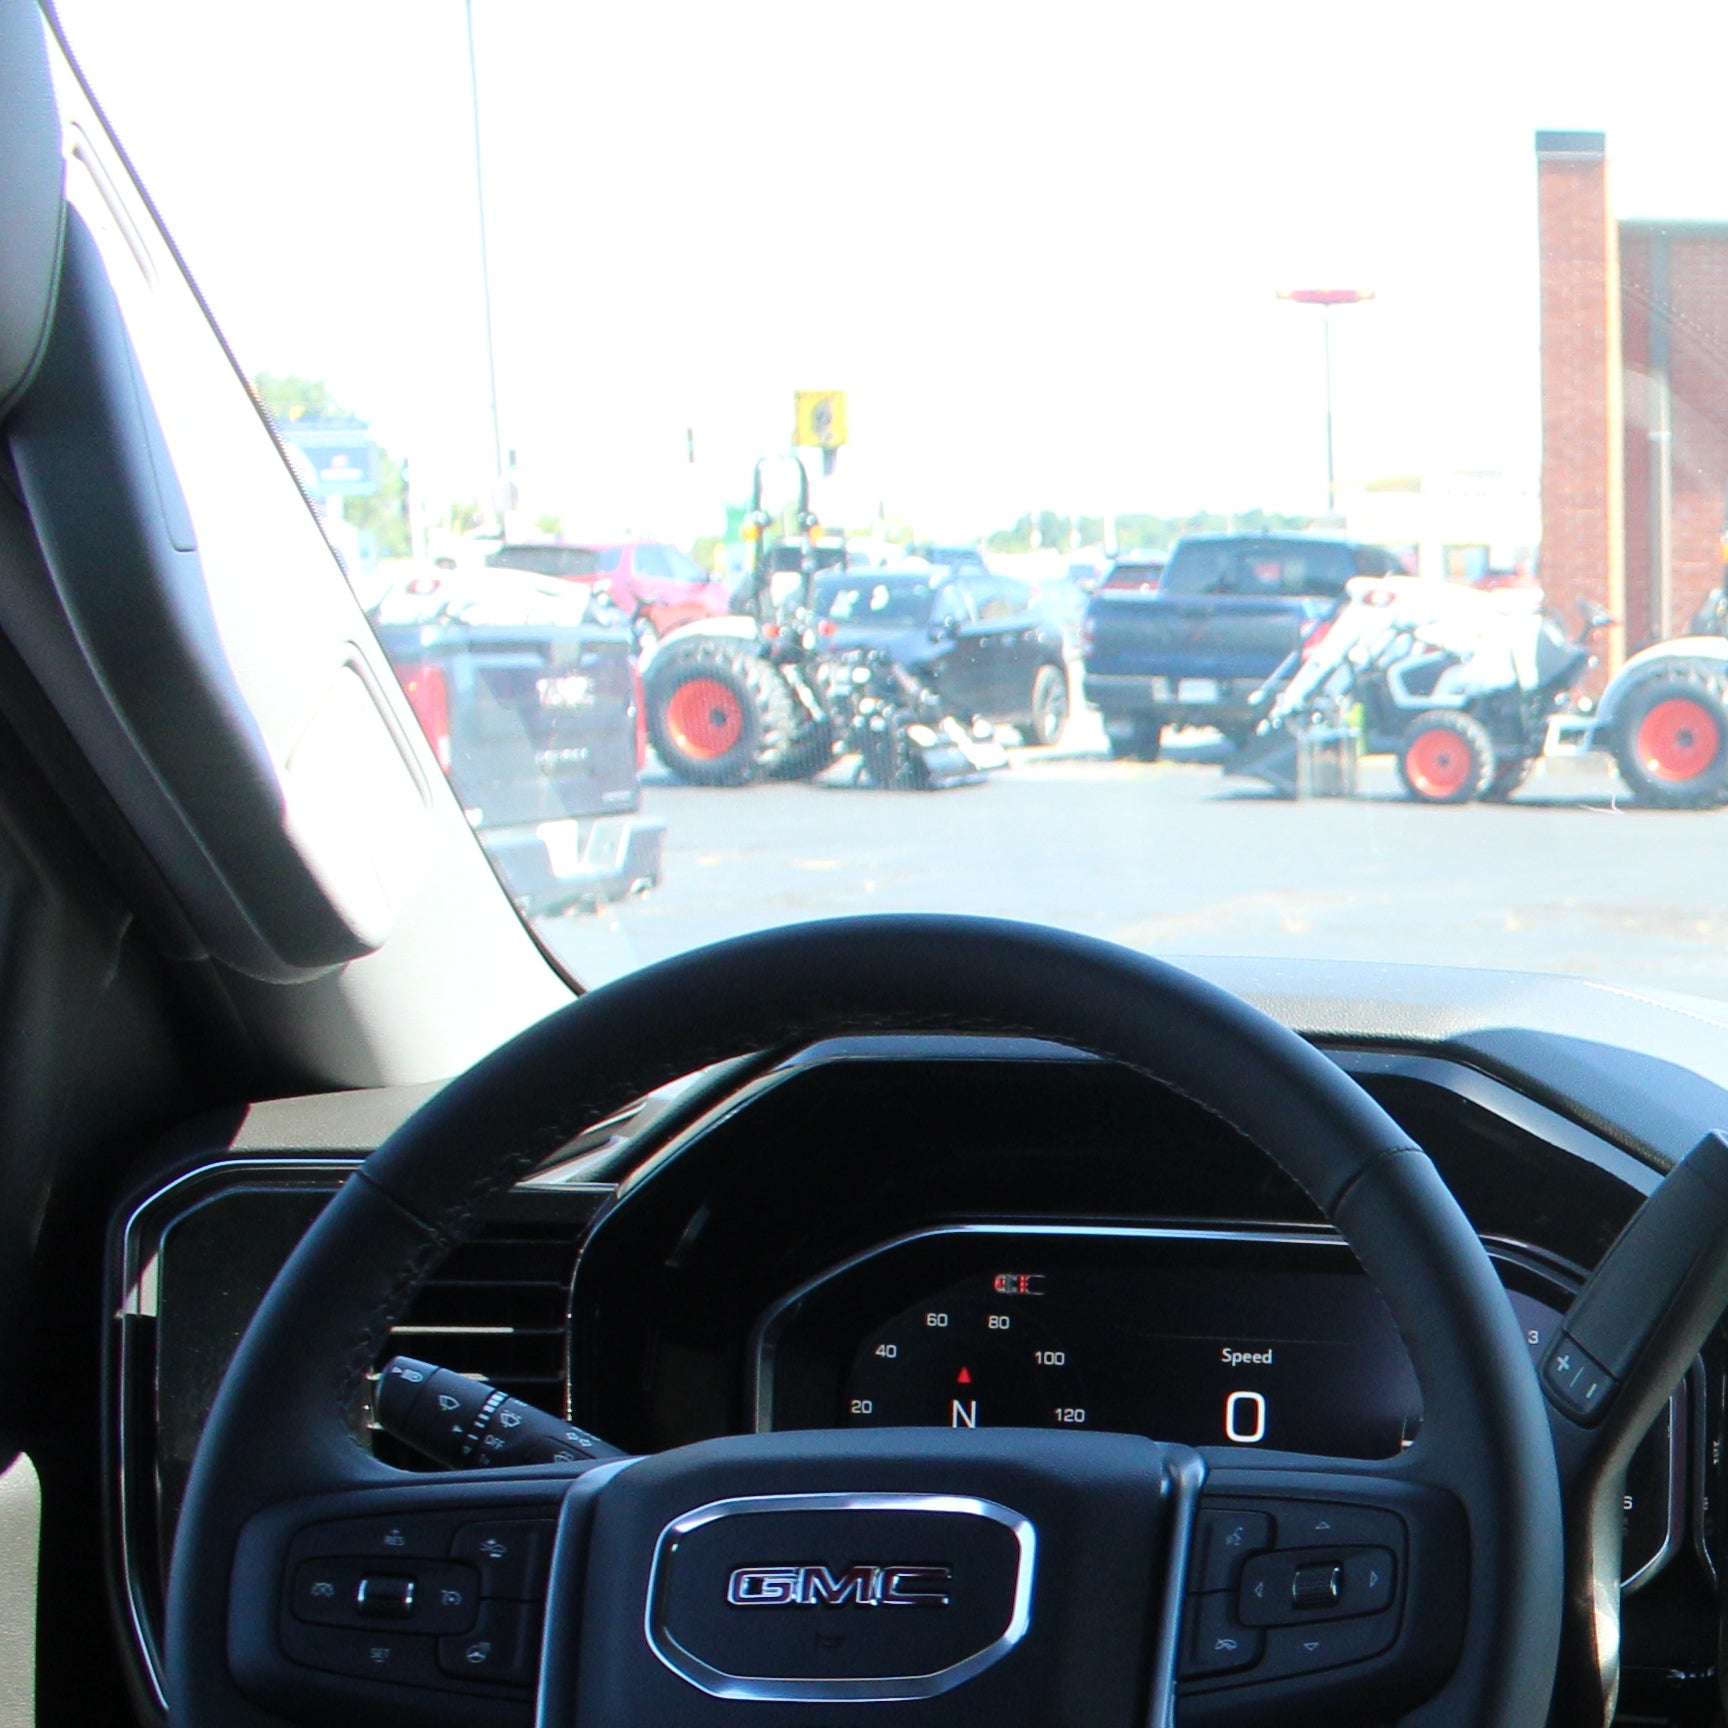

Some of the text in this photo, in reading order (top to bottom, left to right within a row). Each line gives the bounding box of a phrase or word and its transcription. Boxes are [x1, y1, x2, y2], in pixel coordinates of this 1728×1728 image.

[927, 1313, 948, 1327] 60
[988, 1315, 1009, 1330] 80
[875, 1344, 897, 1359] 40
[1035, 1351, 1065, 1366] 100
[1222, 1348, 1272, 1366] Speed
[851, 1400, 872, 1415] 20
[951, 1400, 976, 1428] N
[1055, 1408, 1085, 1423] 120
[1225, 1391, 1265, 1443] 0
[726, 1565, 954, 1606] GMC
